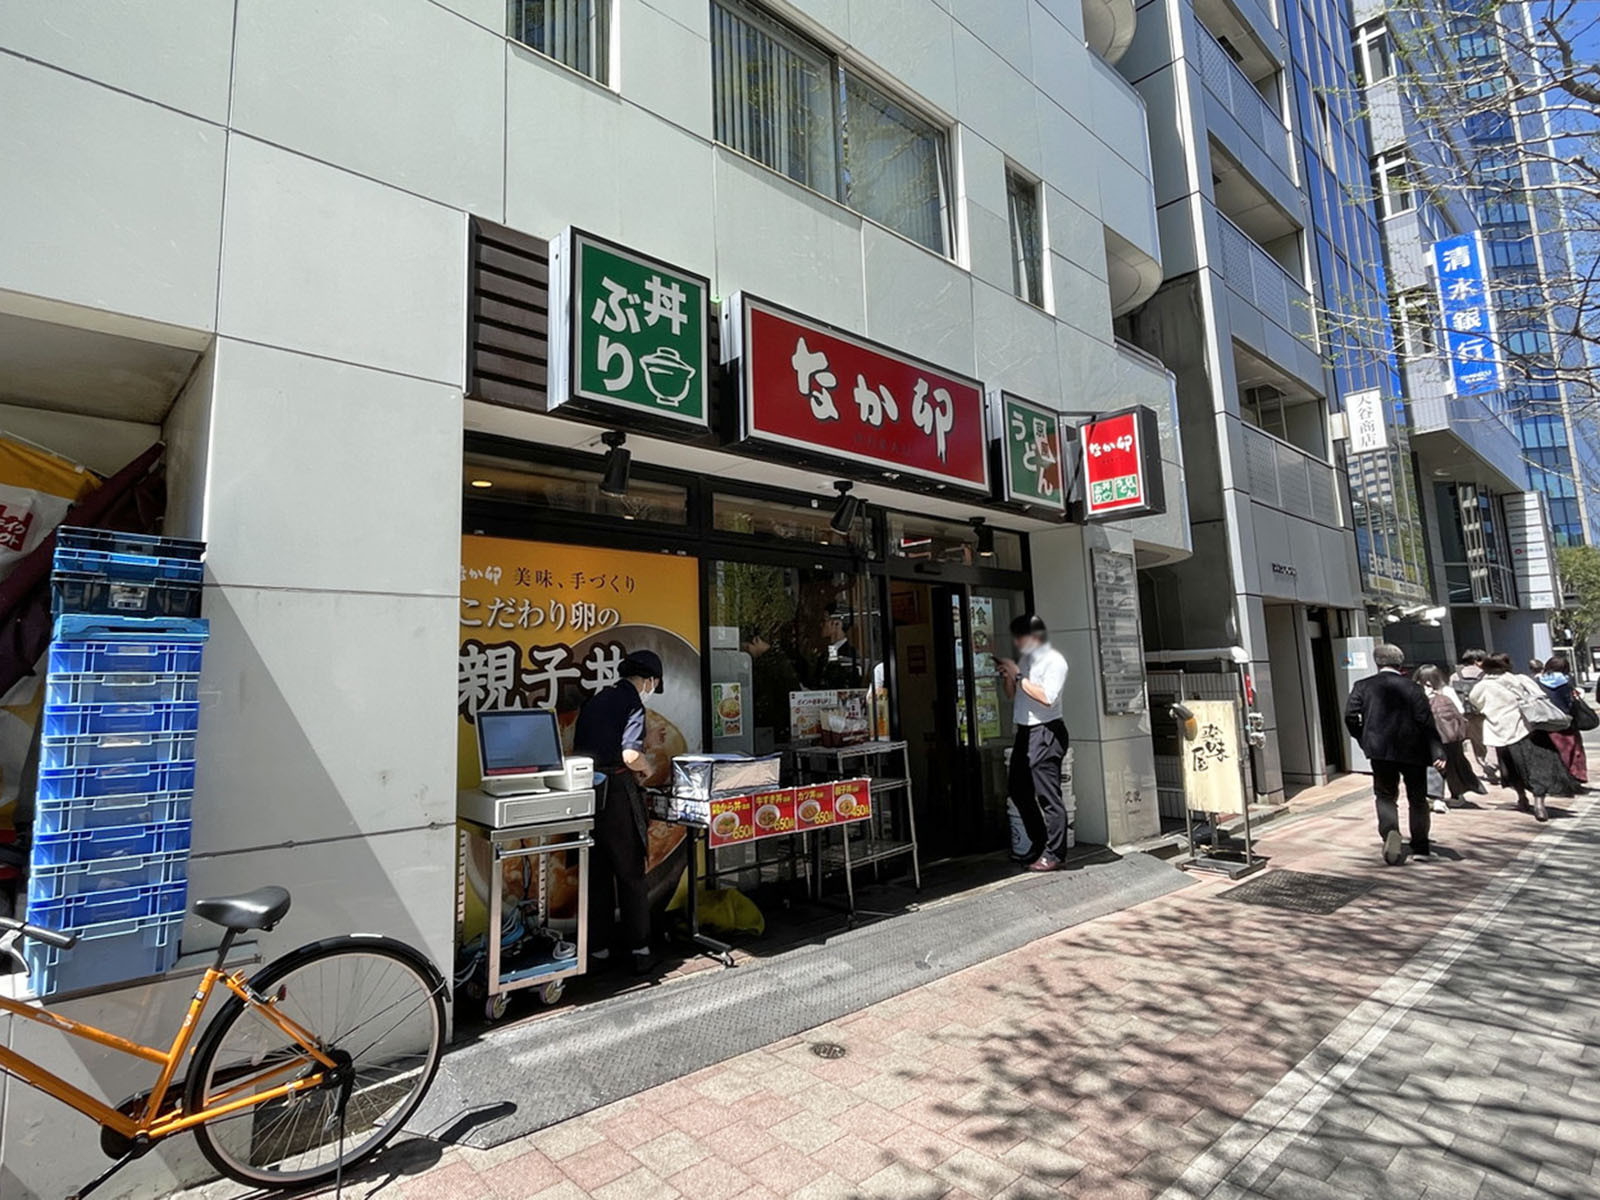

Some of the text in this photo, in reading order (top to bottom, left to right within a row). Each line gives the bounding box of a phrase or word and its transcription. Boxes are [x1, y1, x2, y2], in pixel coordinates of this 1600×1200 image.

[1443, 245, 1486, 364] 清水銀行
[791, 336, 954, 464] なか卯
[1012, 410, 1053, 496] うどん
[460, 597, 621, 631] こだわり卵の
[514, 566, 636, 593] 美味、手づくり
